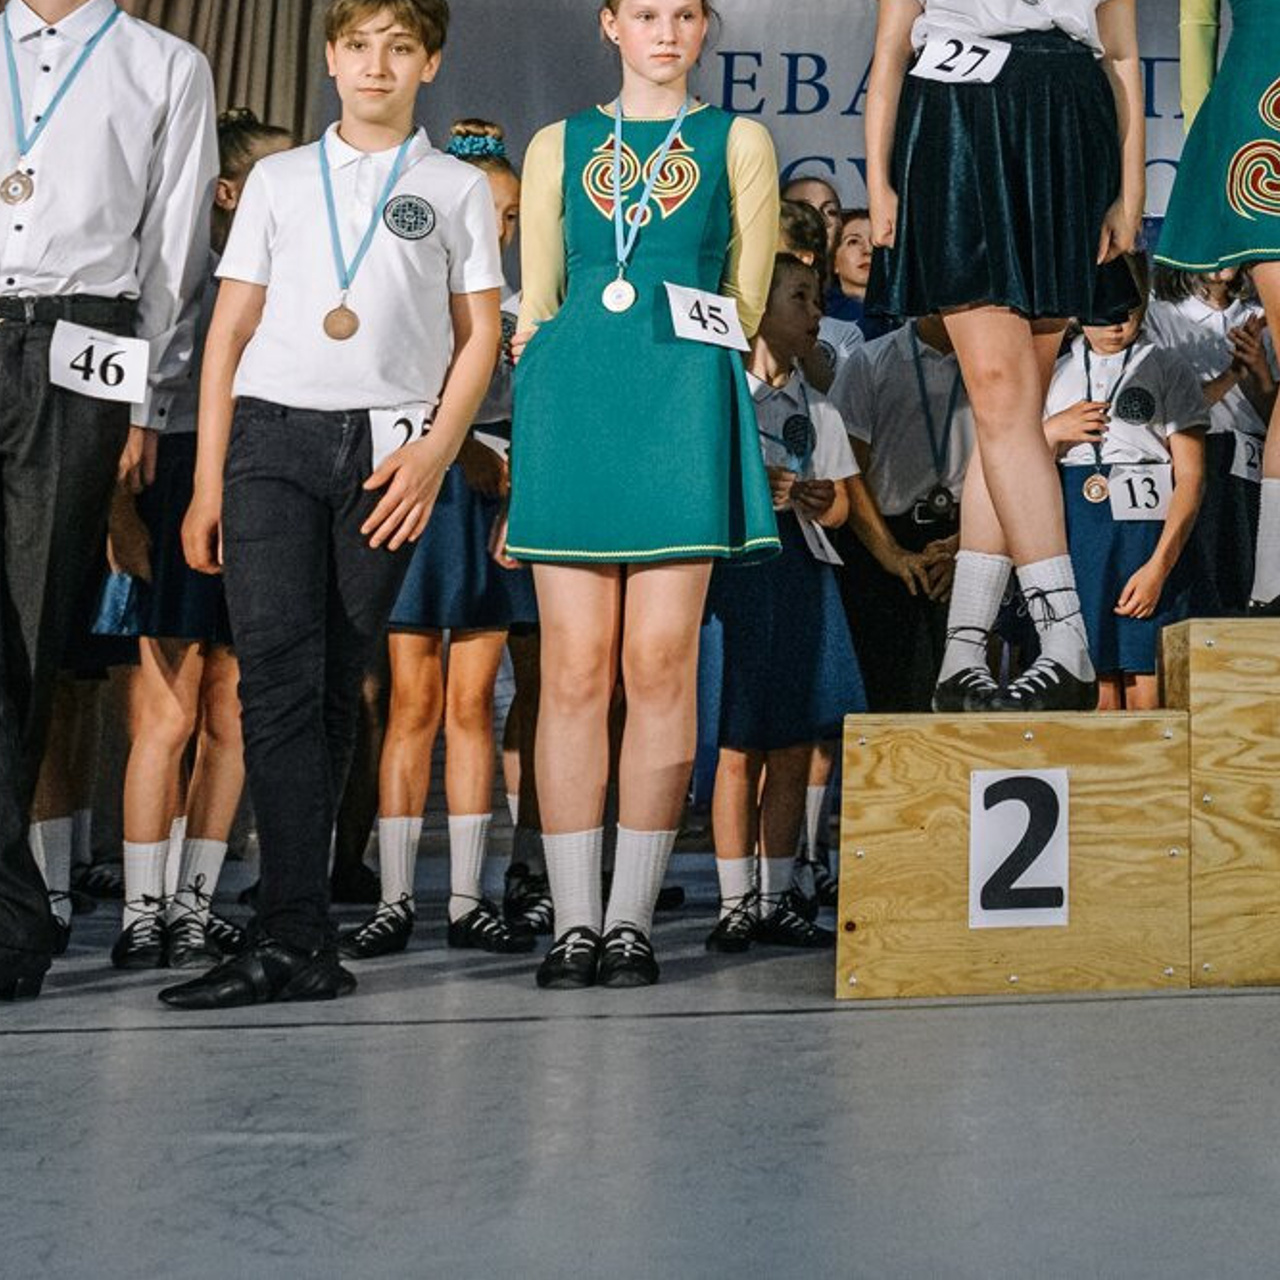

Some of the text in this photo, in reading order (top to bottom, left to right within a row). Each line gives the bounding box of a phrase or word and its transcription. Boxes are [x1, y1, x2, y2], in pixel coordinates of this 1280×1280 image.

[935, 39, 990, 77] 27
[688, 300, 730, 335] 45
[69, 344, 127, 387] 46
[1123, 476, 1160, 510] 13
[980, 776, 1064, 911] 2
